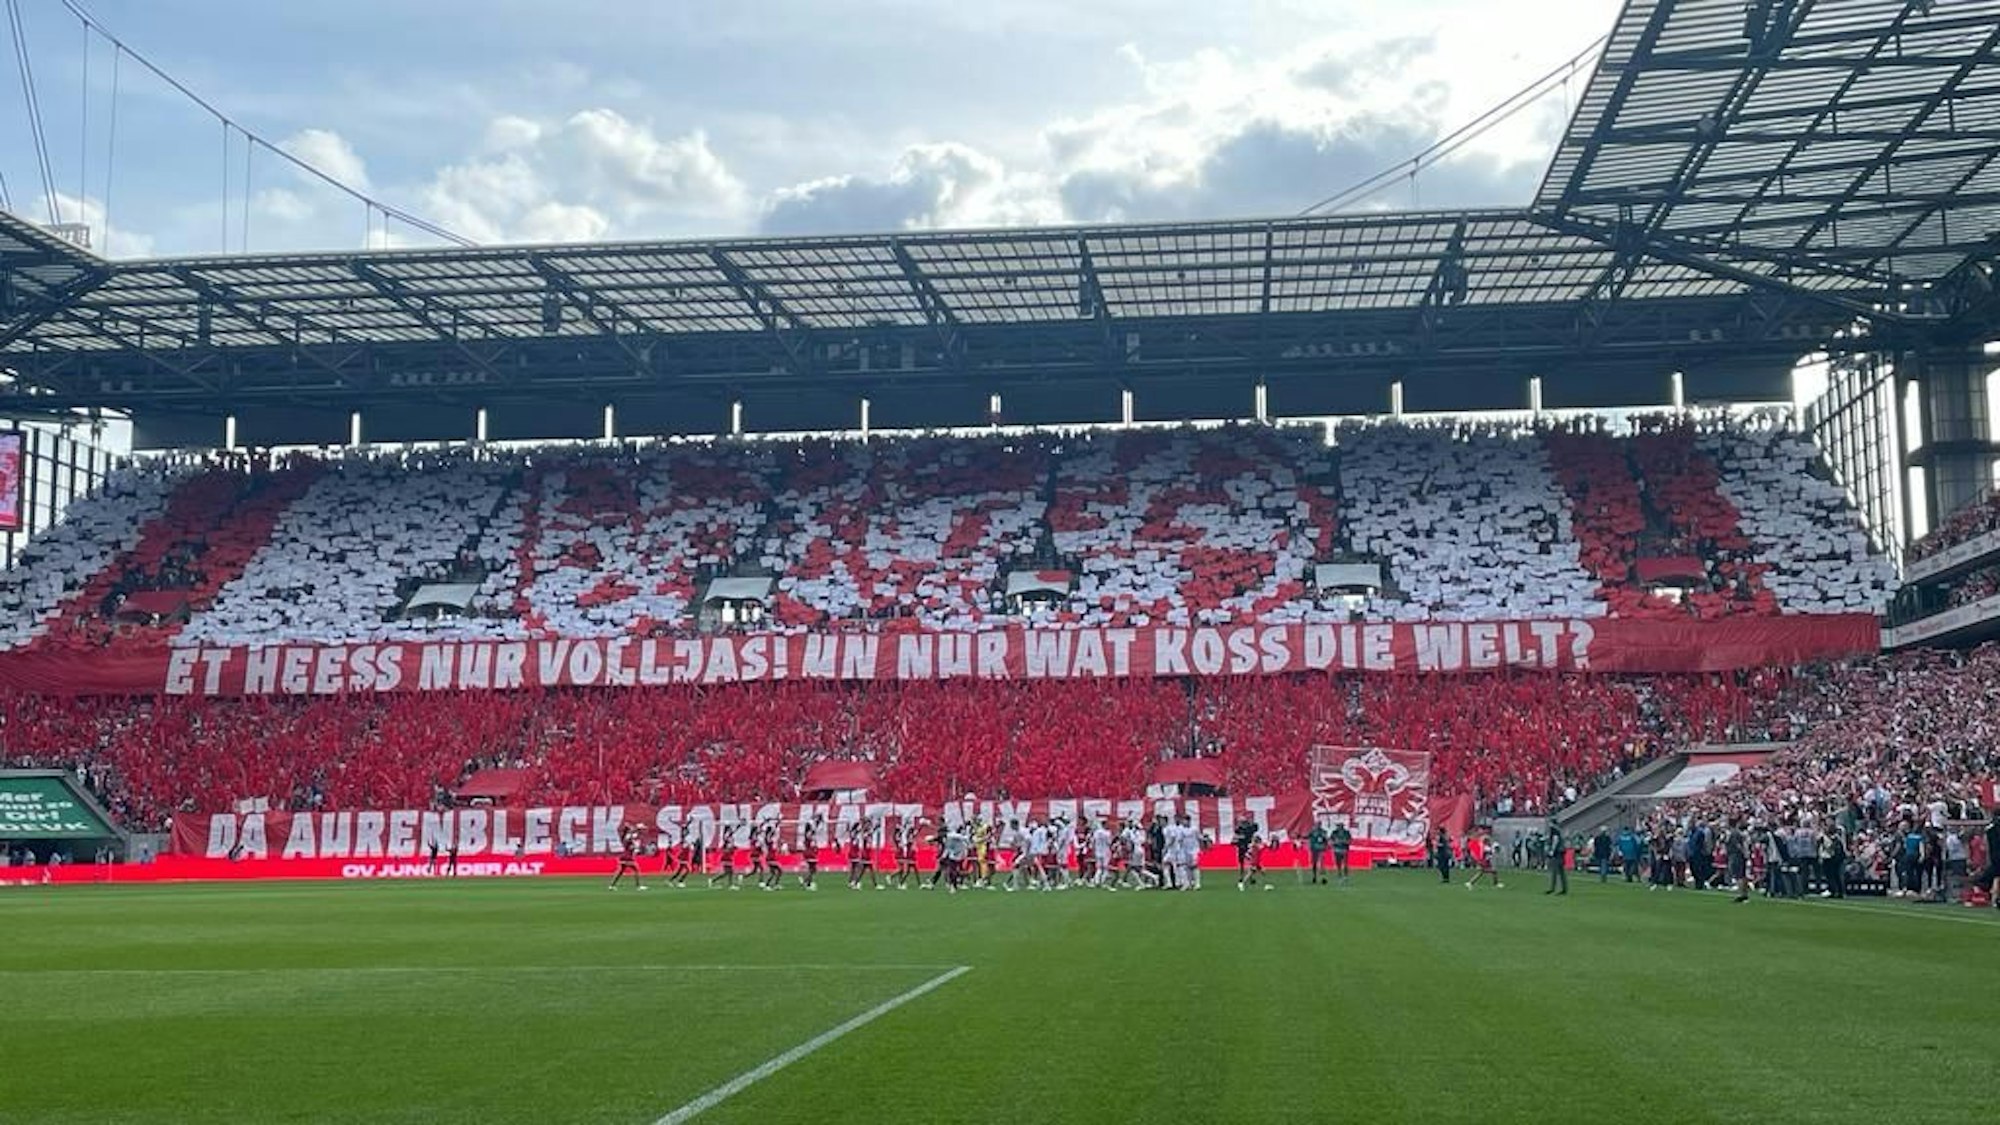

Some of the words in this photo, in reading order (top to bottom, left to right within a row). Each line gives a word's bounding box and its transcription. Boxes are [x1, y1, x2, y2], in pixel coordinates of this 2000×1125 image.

[165, 646, 231, 695] ET
[244, 642, 402, 694] HEESS
[418, 642, 526, 691] NUR
[801, 633, 880, 679] UN
[897, 632, 1010, 680] NUR
[1024, 627, 1136, 678] WAT
[1155, 624, 1291, 675] KOSS
[1304, 622, 1395, 671] DIE
[1414, 619, 1596, 671] WELT?
[503, 862, 544, 875] ALT
